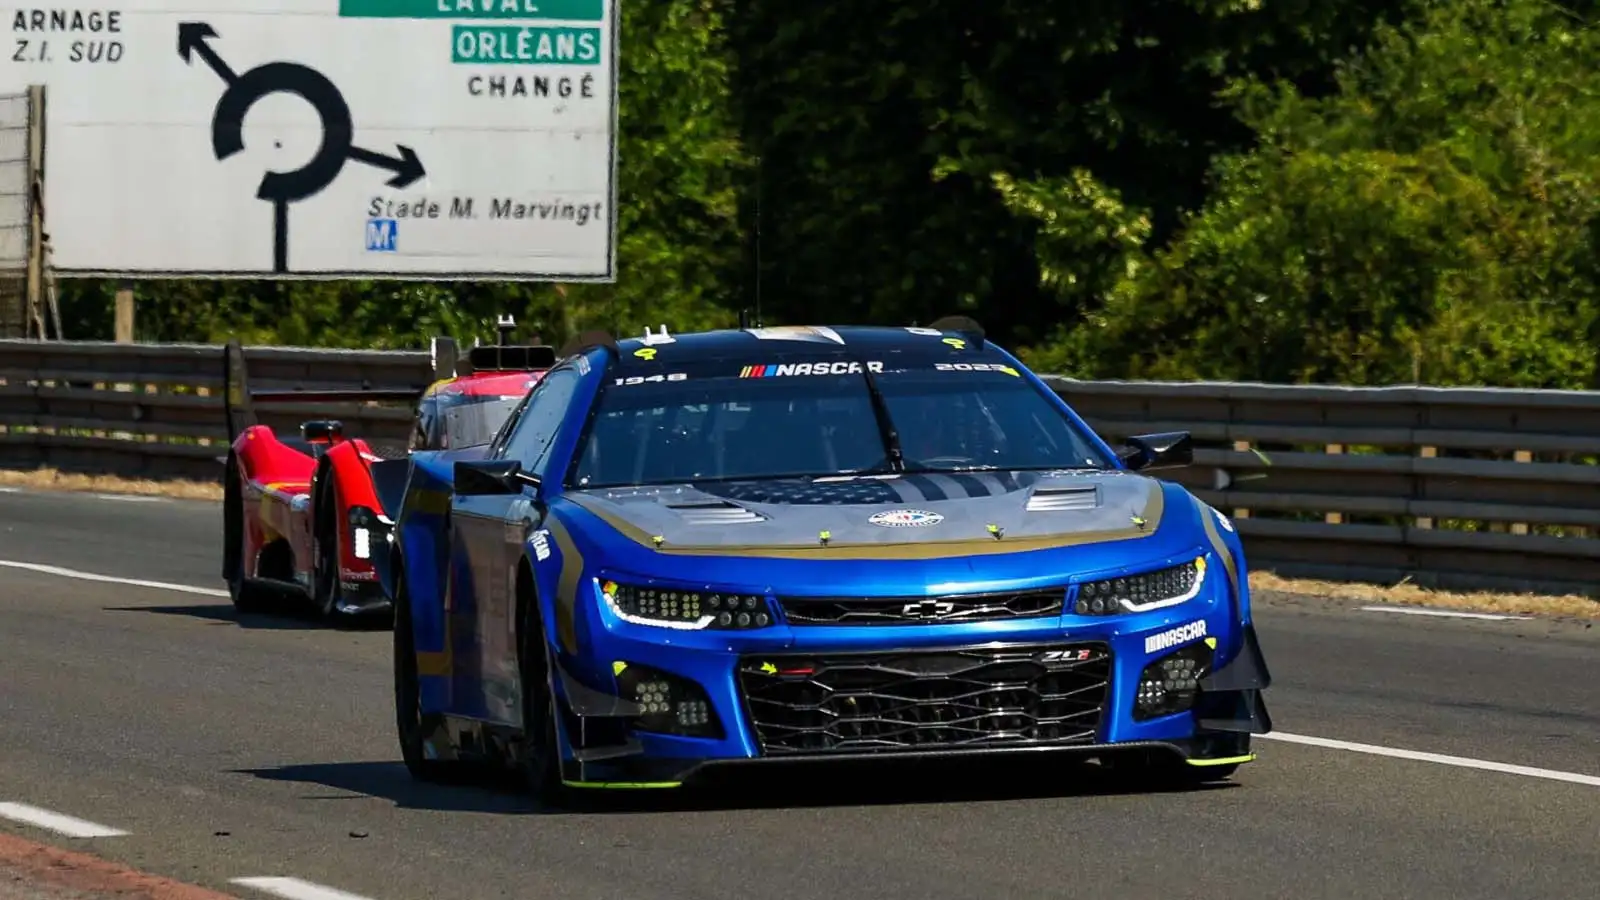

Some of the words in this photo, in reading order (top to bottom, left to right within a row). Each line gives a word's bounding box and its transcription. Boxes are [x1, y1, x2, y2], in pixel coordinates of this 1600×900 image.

[12, 10, 122, 32] ARNAGE
[12, 40, 53, 62] Z.I.
[69, 42, 125, 63] SUD
[456, 27, 597, 60] ORLÉANS
[467, 72, 595, 98] CHANGÉ
[367, 197, 441, 218] Stade
[449, 197, 478, 218] M.
[488, 198, 603, 226] Marvingt
[615, 373, 688, 386] 1948
[775, 361, 884, 377] NASCAR
[1160, 619, 1207, 649] NASCAR
